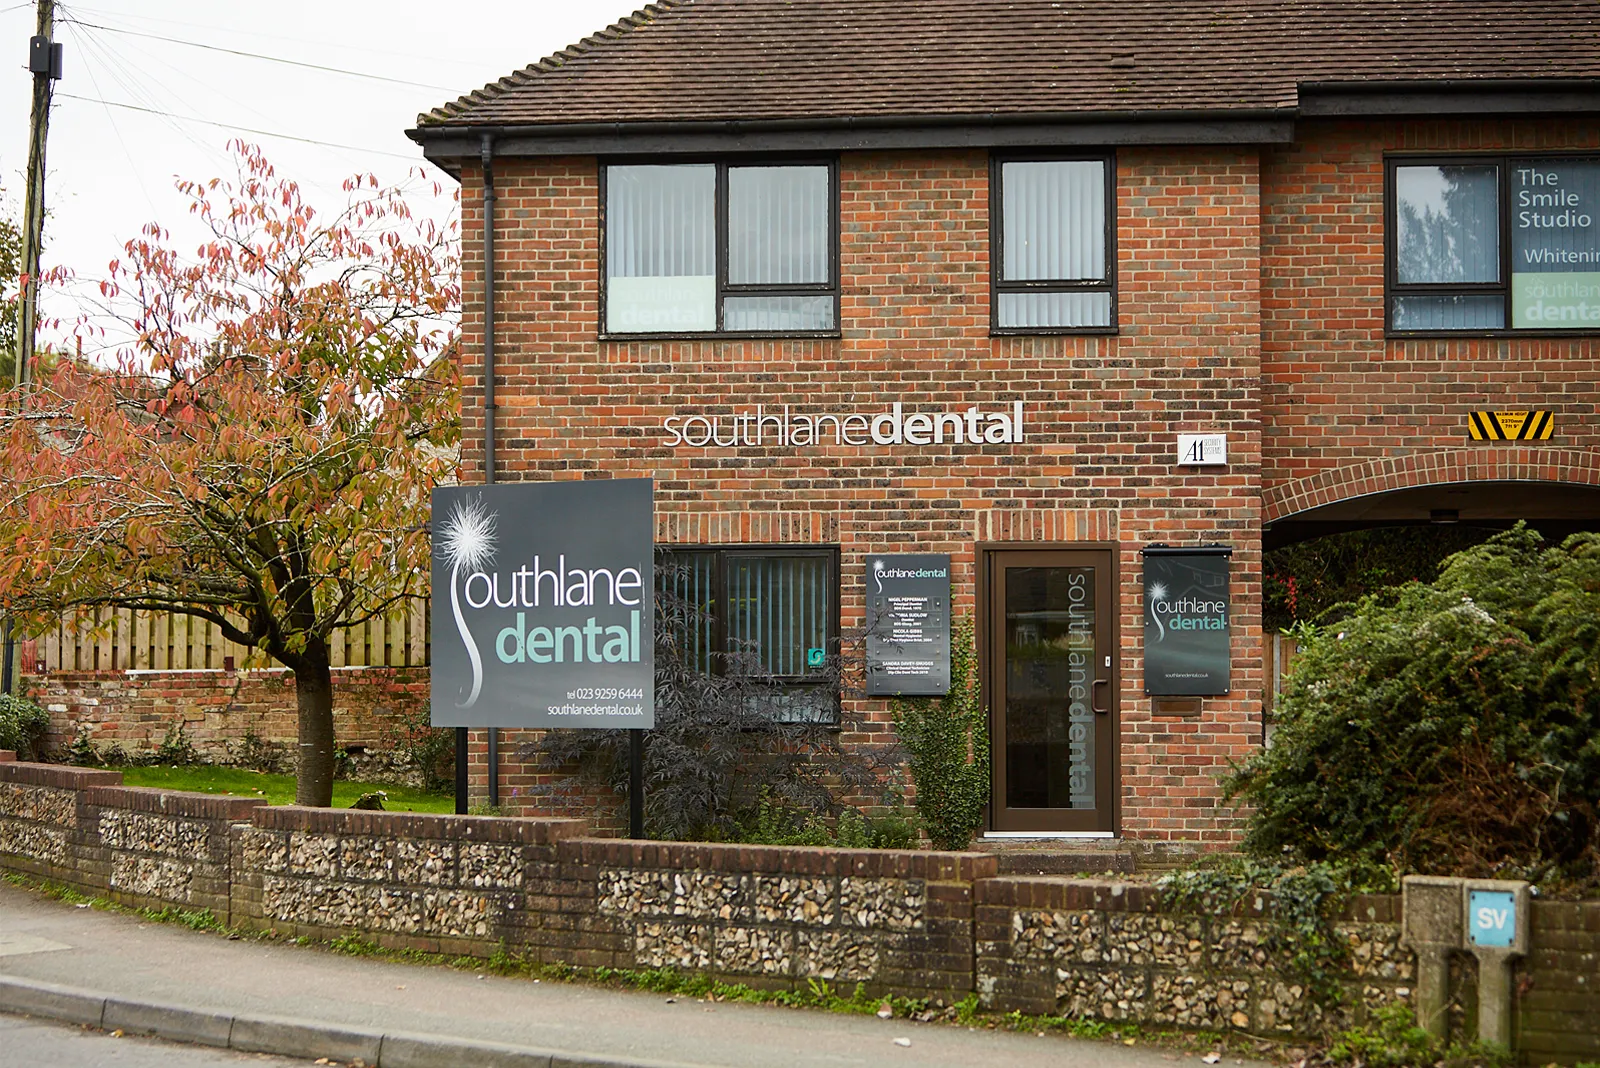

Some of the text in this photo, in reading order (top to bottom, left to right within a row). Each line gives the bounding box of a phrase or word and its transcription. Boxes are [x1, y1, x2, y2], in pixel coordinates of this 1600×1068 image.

[1518, 168, 1559, 186] The
[1518, 189, 1580, 207] Smile
[1519, 210, 1592, 228] Studio
[1169, 613, 1225, 630] dental
[495, 610, 641, 664] dental
[567, 688, 643, 700] tel 023 9259 6444
[547, 703, 643, 716] southlanedental.co.uk
[1477, 907, 1508, 930] SV
